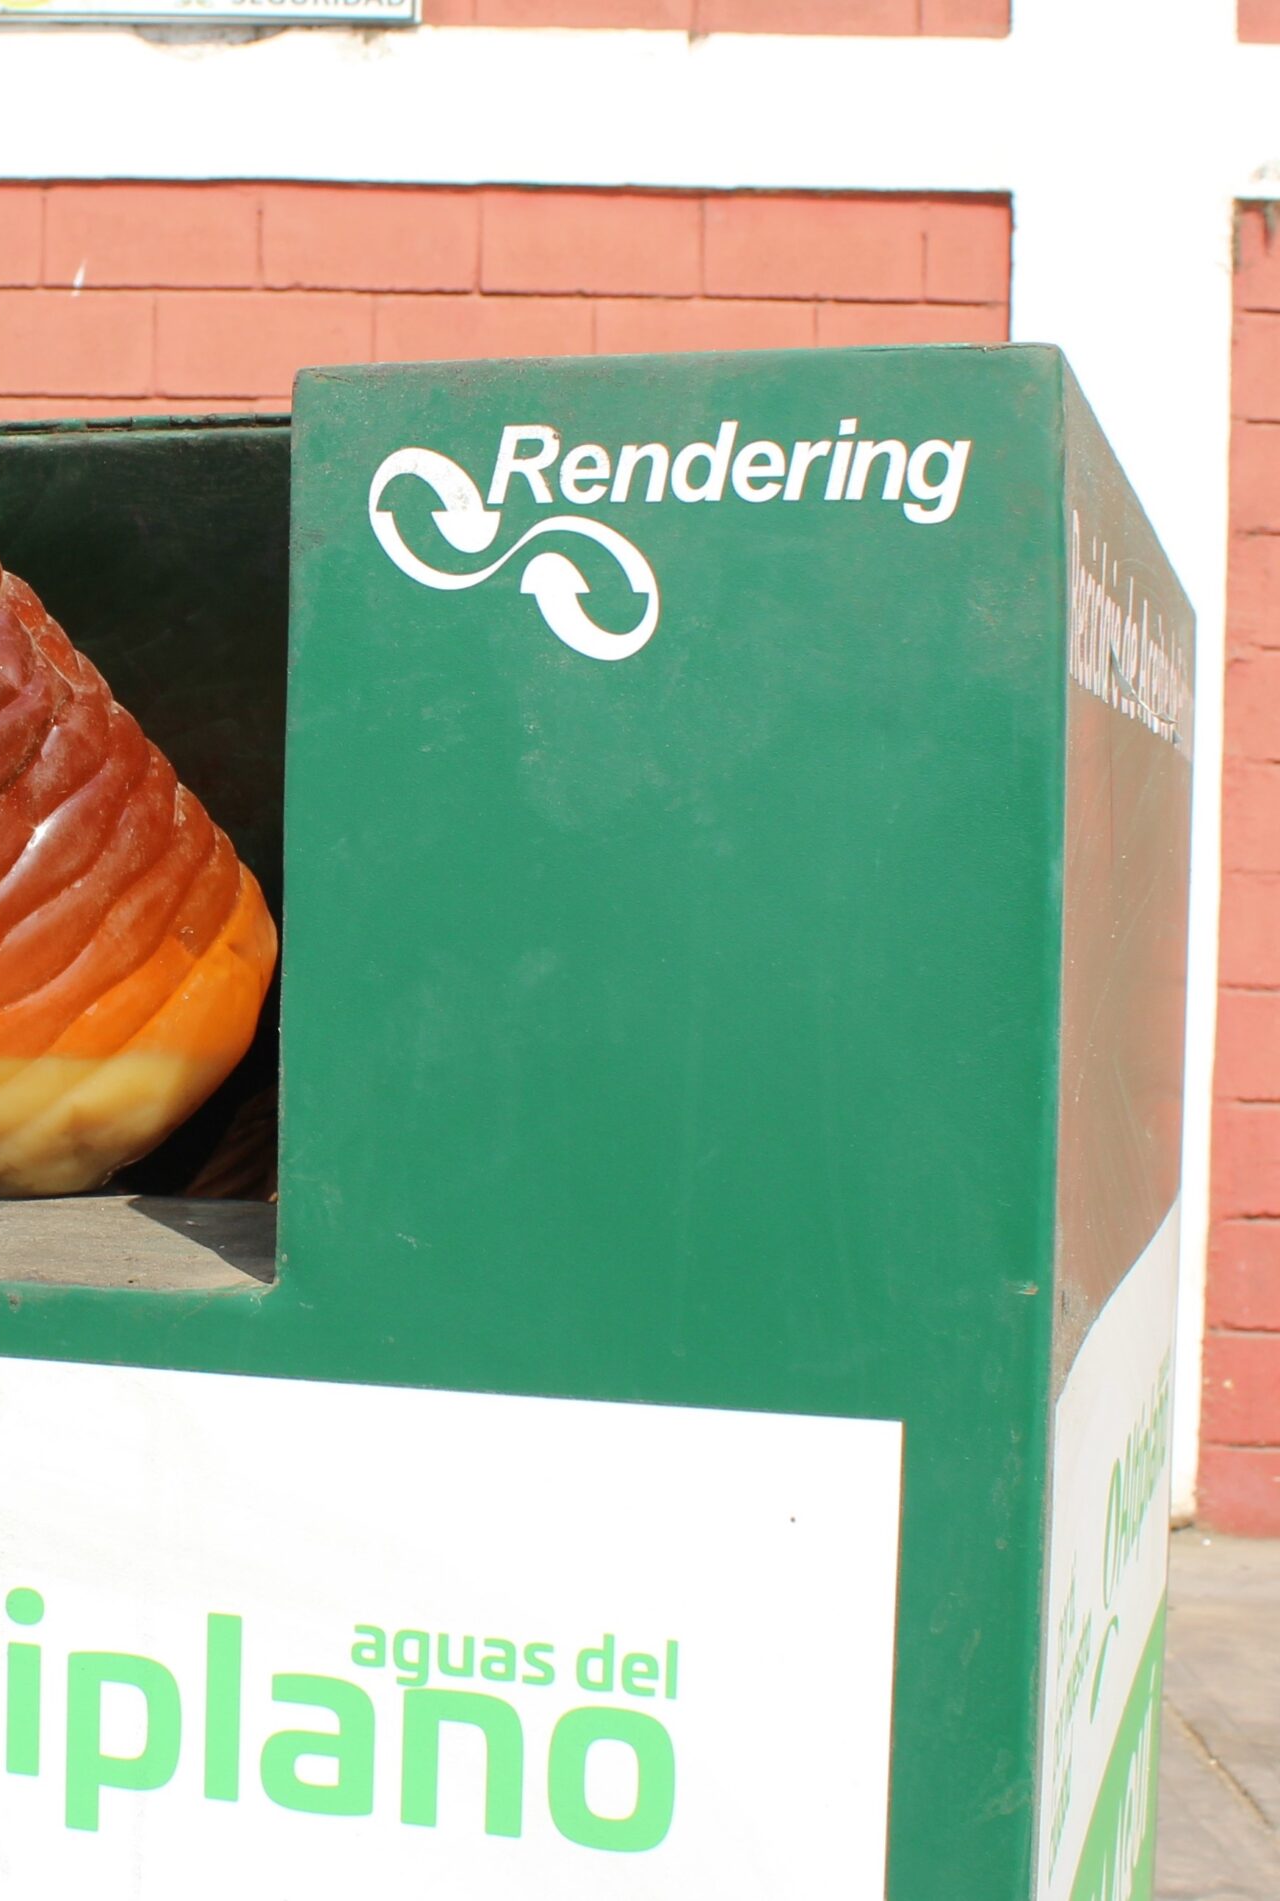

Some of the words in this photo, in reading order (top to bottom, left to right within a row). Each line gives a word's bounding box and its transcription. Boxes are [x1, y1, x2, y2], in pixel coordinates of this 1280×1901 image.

[486, 418, 971, 525] Rendering
[351, 1624, 555, 1688] aguas
[575, 1633, 679, 1700] del
